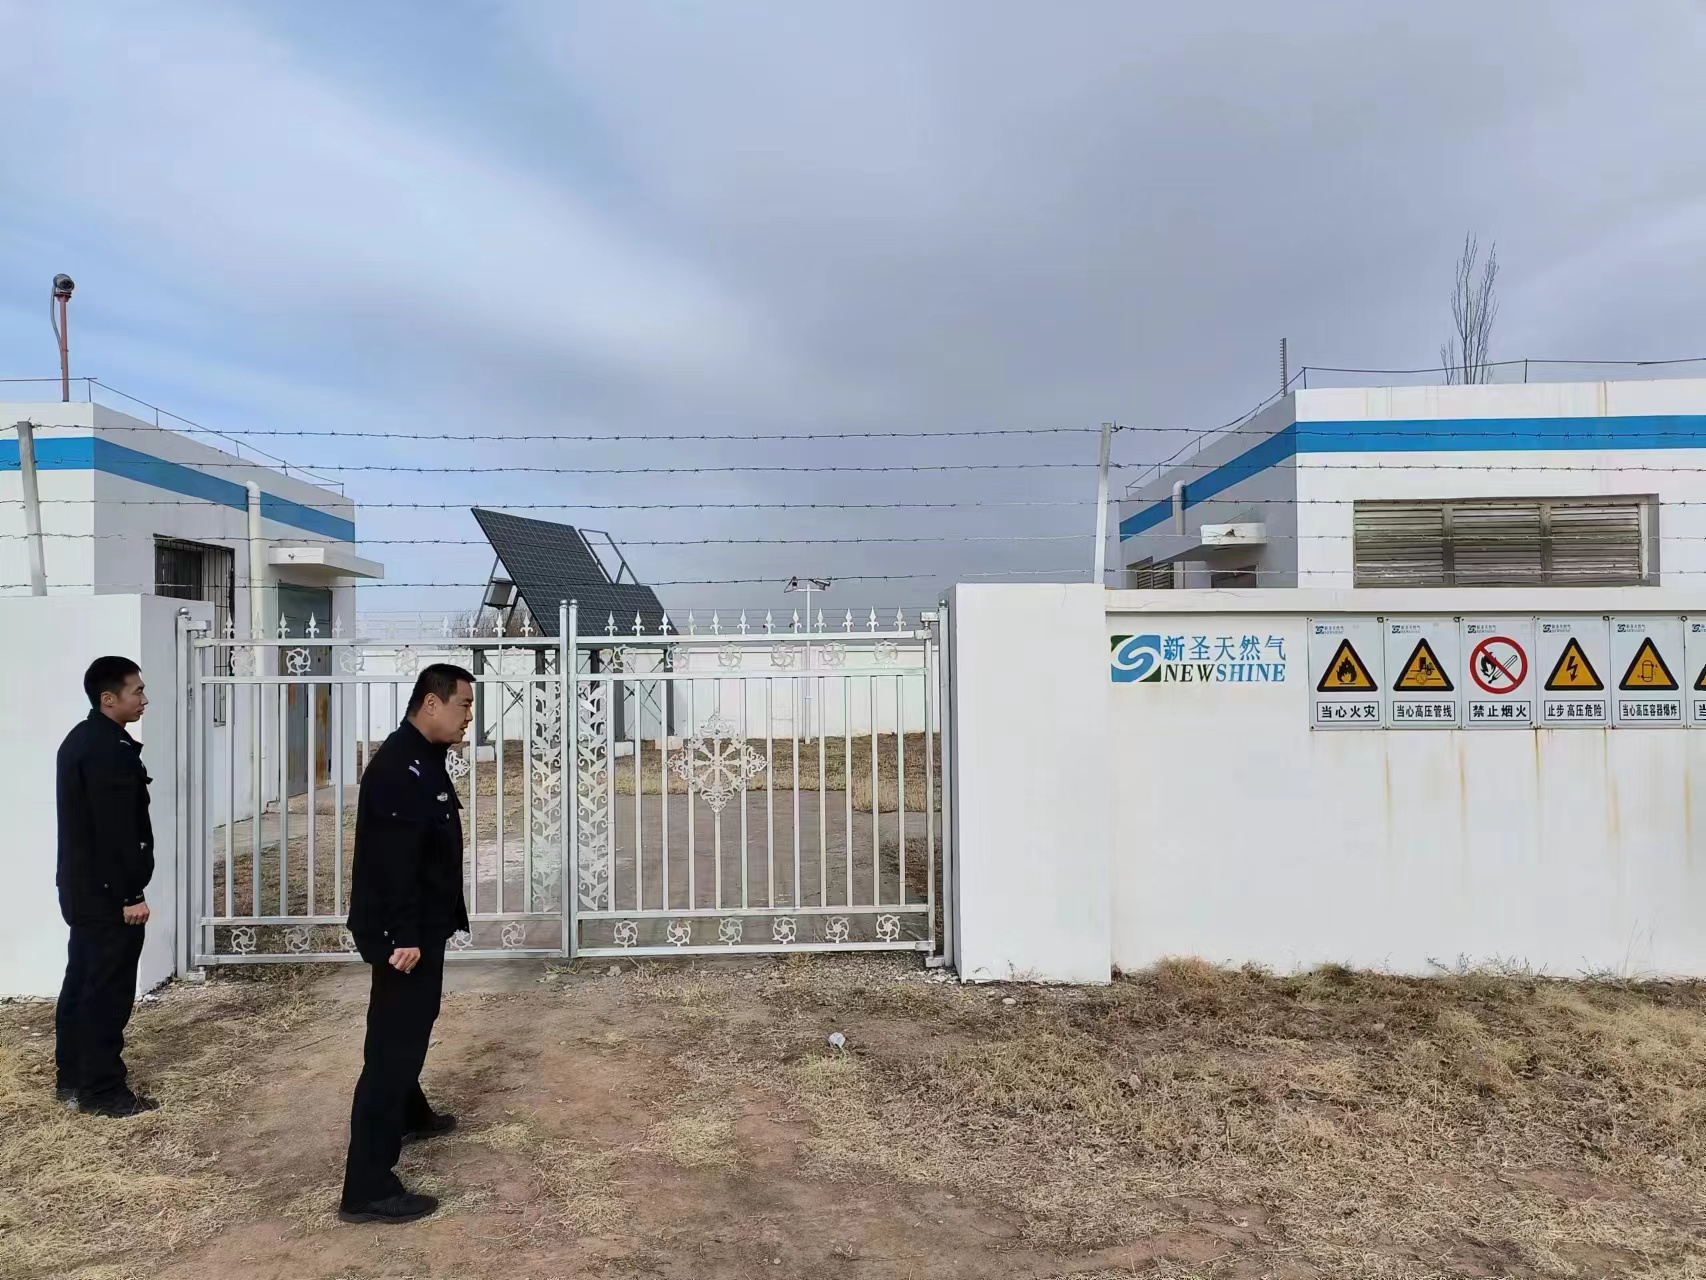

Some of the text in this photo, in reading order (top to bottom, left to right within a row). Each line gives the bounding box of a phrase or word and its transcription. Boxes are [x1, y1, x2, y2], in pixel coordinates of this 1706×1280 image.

[1163, 635, 1286, 661] 新圣天然气
[1163, 663, 1286, 682] NEWSHINE
[1321, 704, 1376, 718] 当心火灾
[1396, 704, 1452, 718] 当心高压管线
[1472, 704, 1527, 717] 禁止烟火
[1622, 704, 1678, 717] 当心高压容器爆炸
